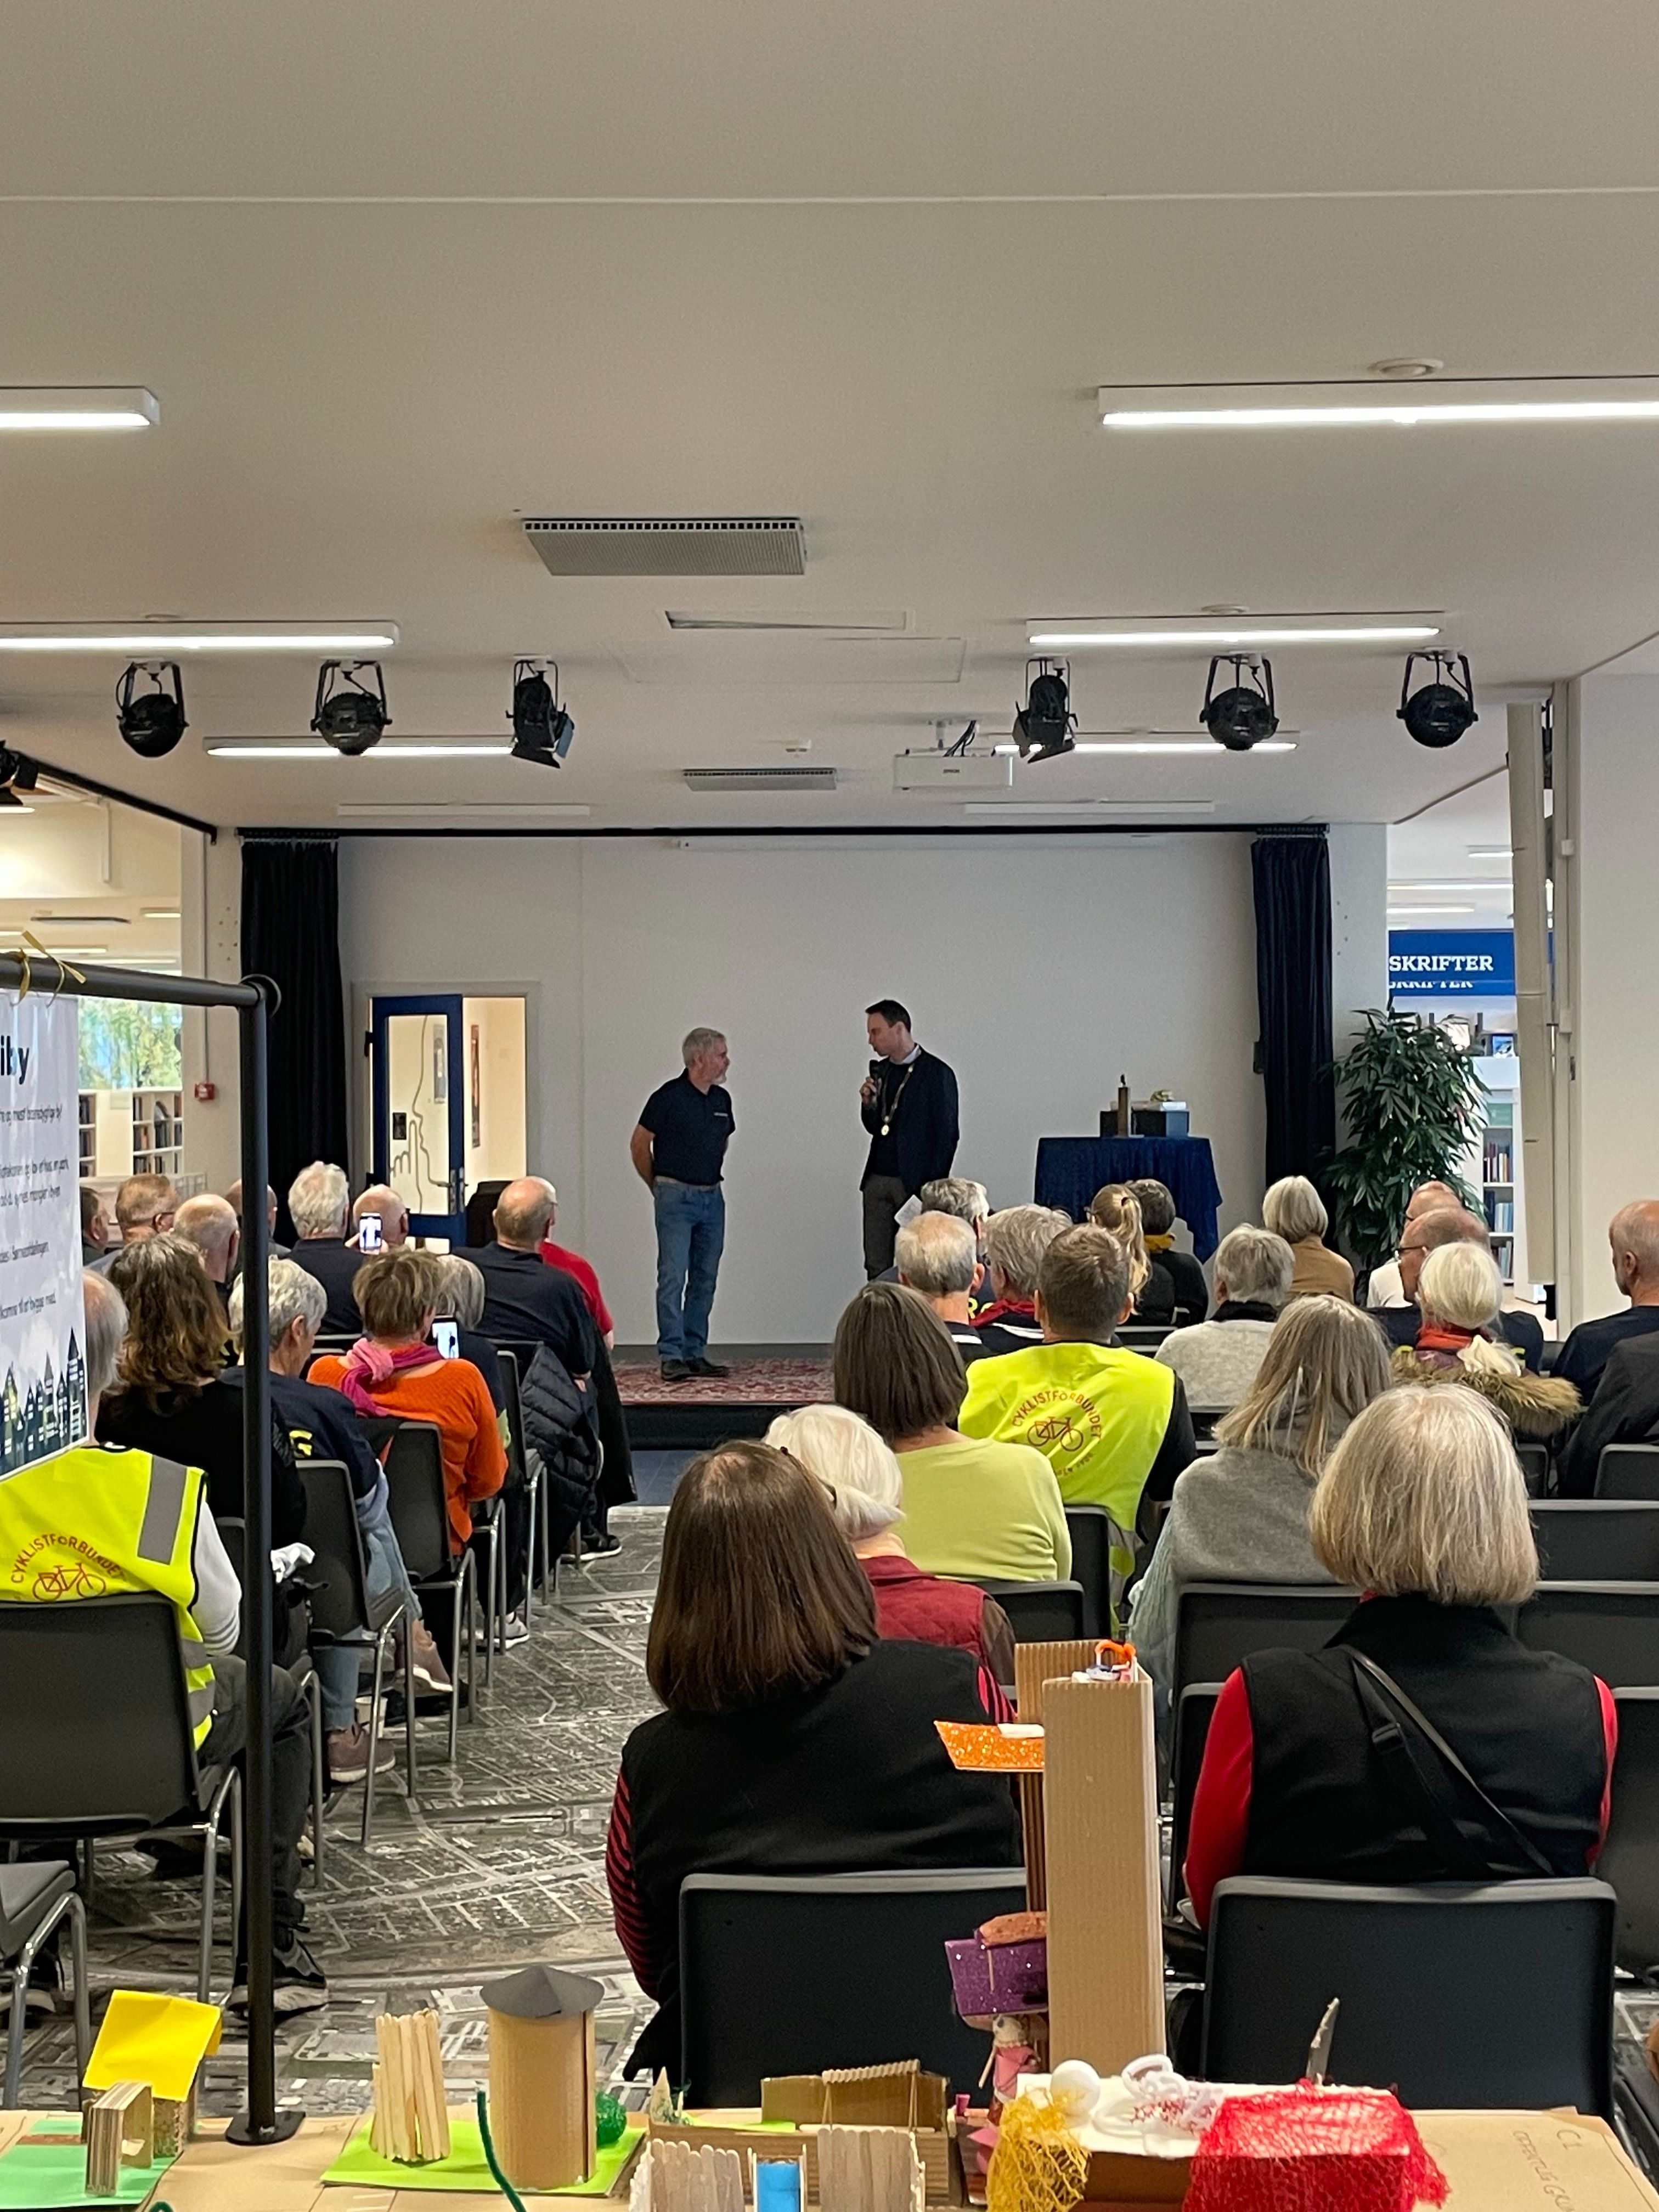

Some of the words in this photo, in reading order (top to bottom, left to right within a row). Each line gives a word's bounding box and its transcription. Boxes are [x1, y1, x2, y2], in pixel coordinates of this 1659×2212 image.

[1389, 955, 1494, 972] SKRIFTER
[1012, 1390, 1102, 1438] CYKLISTFORBUNDET
[11, 1533, 126, 1583] CYKLISTFORBUNDET
